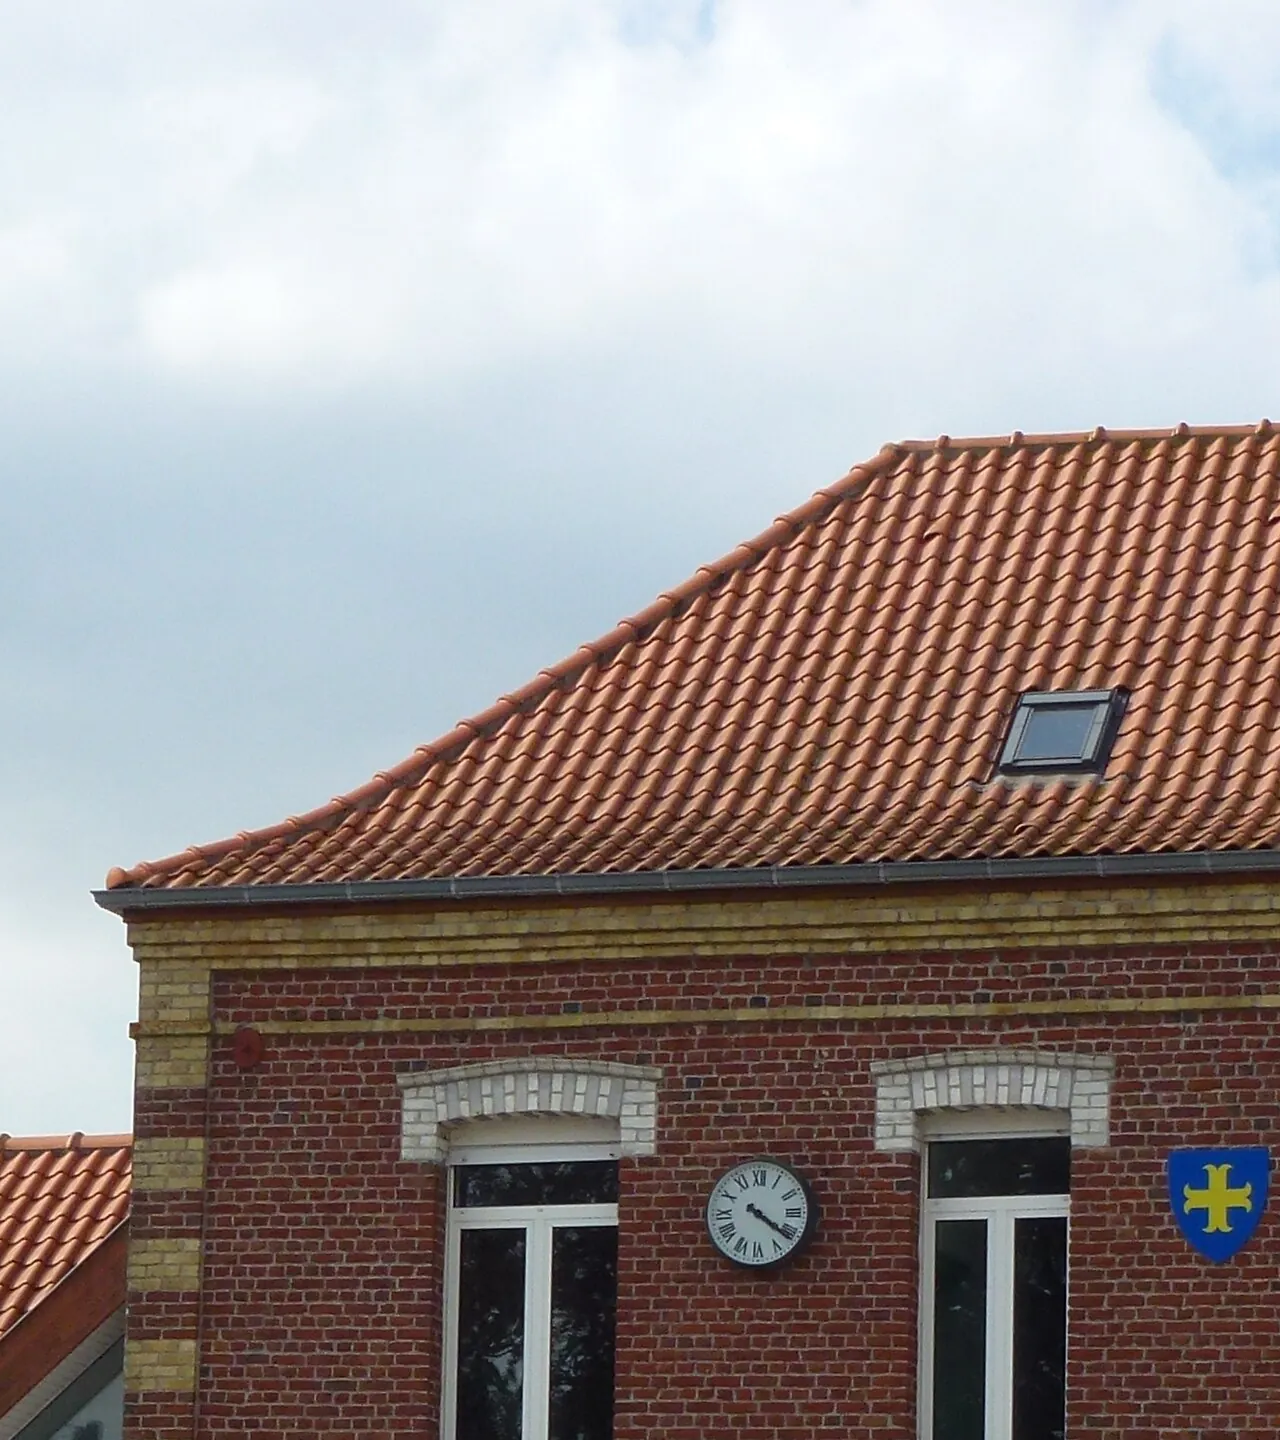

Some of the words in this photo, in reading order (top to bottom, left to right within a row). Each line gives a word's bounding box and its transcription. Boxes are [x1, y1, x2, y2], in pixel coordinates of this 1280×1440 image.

[733, 1174, 749, 1192] XI
[752, 1170, 767, 1186] XII
[771, 1174, 782, 1189] I
[721, 1189, 737, 1204] X
[781, 1188, 797, 1201] II
[716, 1209, 732, 1220] IX
[785, 1207, 801, 1218] III
[718, 1223, 736, 1244] VIII
[733, 1237, 748, 1256] VII
[753, 1241, 764, 1258] VI
[772, 1238, 782, 1254] V
